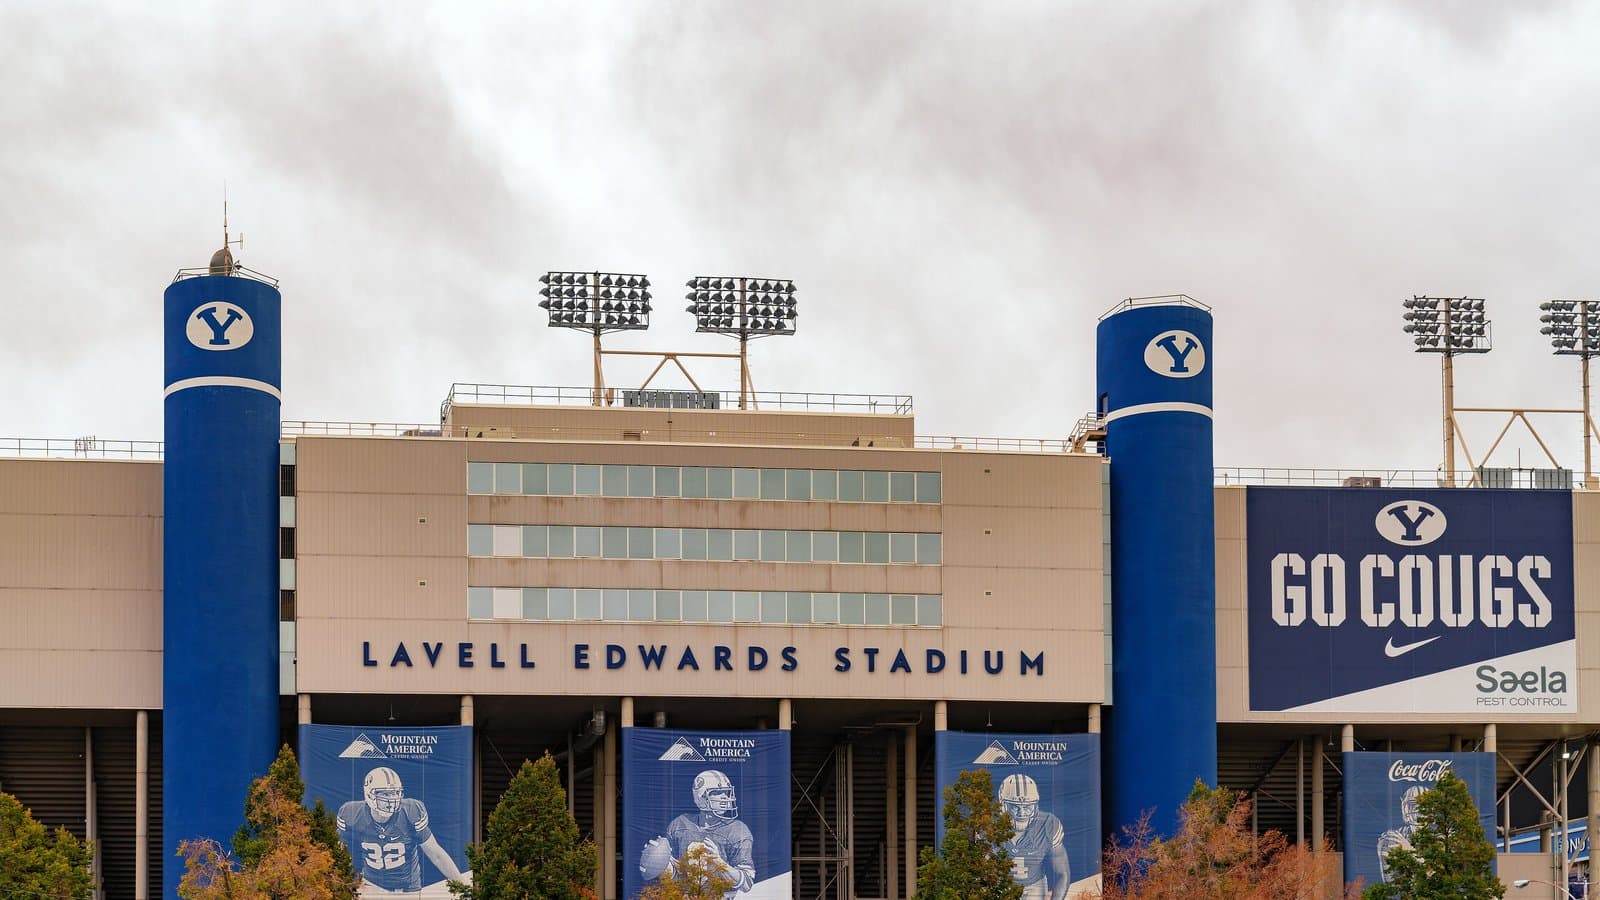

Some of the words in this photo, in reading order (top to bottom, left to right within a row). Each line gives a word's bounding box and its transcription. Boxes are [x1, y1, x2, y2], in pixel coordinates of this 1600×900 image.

[196, 306, 243, 346] Y
[1155, 335, 1198, 373] Y
[1387, 504, 1436, 541] Y
[1271, 553, 1347, 627] GO
[1360, 554, 1553, 628] COUGS
[362, 641, 536, 669] LAVELL
[574, 643, 798, 672] EDWARDS
[834, 647, 1044, 676] STADIUM
[1475, 664, 1567, 694] Saela
[1476, 697, 1507, 706] PEST
[1509, 697, 1567, 707] CONTROL
[381, 734, 438, 745] MOUNTAIN
[385, 744, 433, 754] AMERICA
[700, 738, 755, 748] MOUNTAIN
[1013, 741, 1067, 752] MOUNTAIN
[704, 747, 751, 757] AMERICA
[1017, 751, 1063, 761] AMERICA
[361, 842, 406, 870] 32
